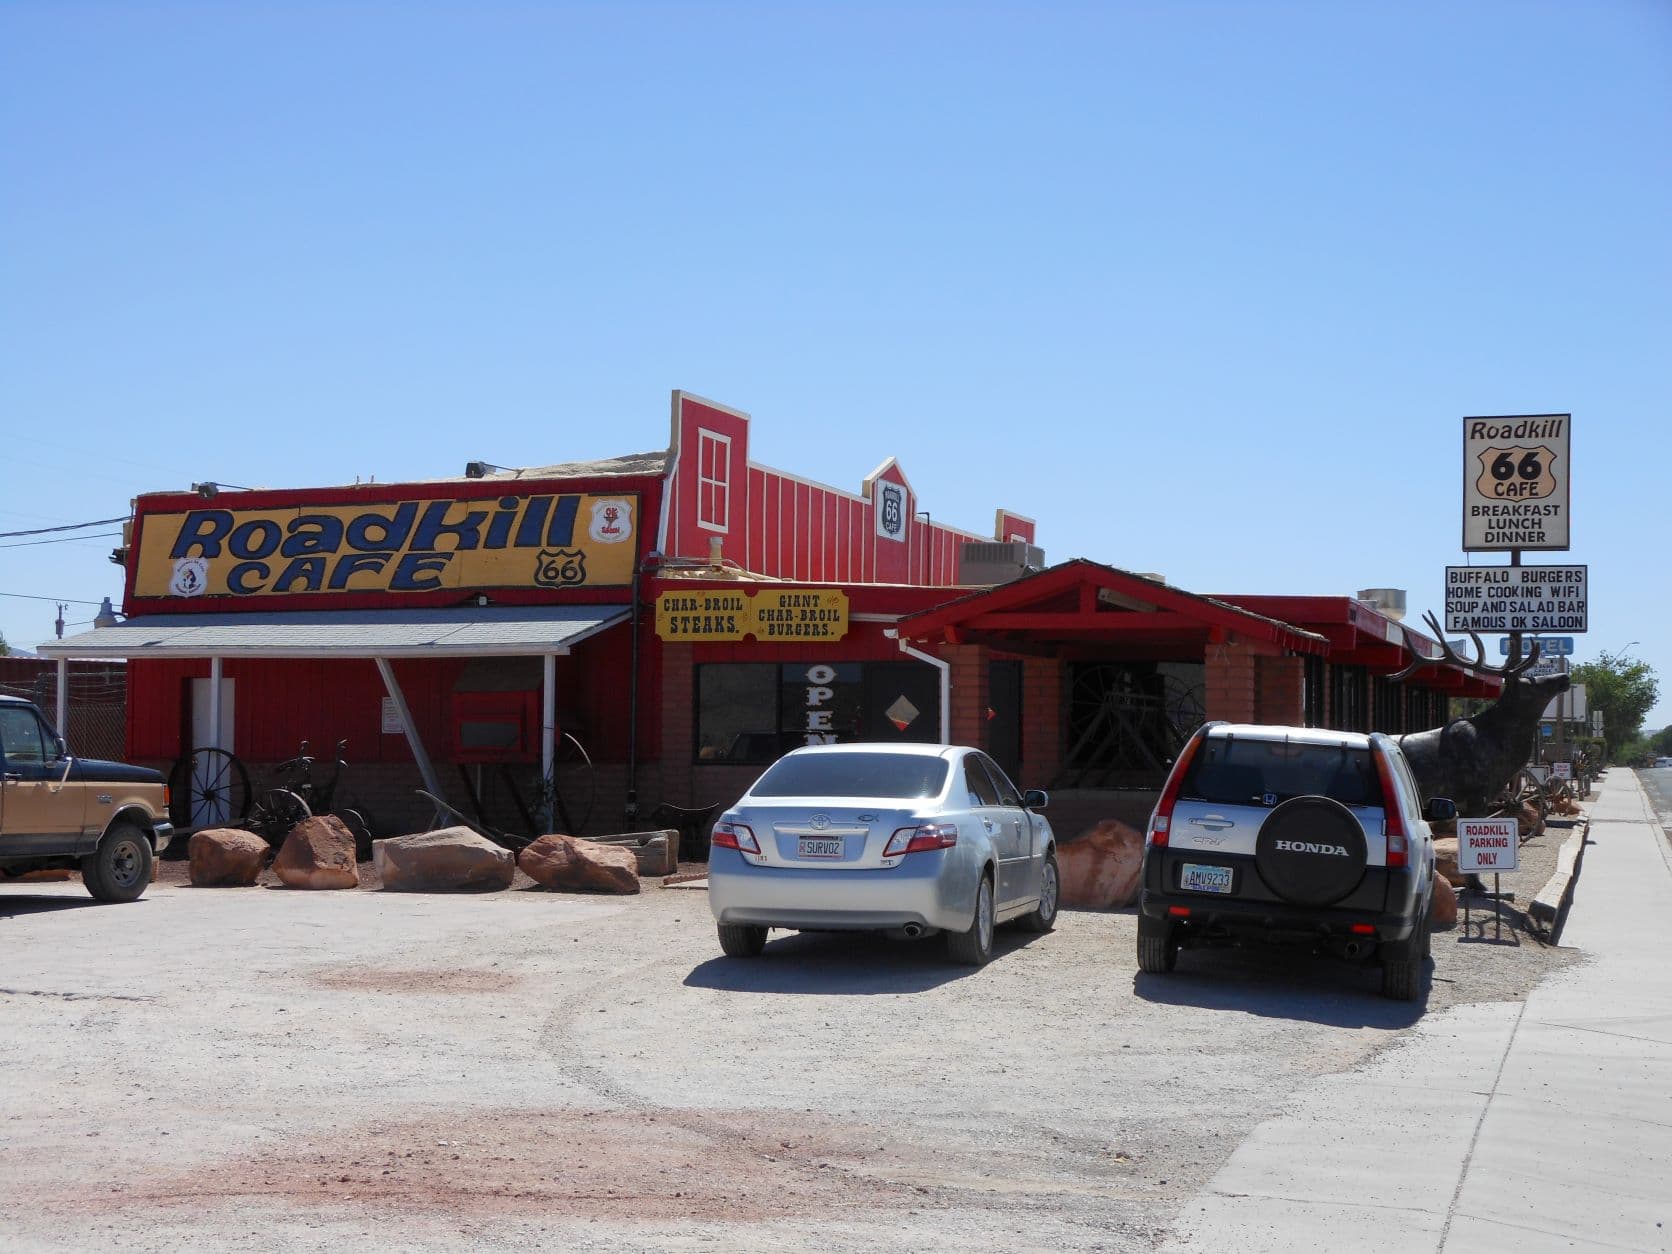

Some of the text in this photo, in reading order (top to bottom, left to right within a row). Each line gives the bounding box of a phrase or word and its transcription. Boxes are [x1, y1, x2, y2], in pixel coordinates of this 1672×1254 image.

[1470, 419, 1564, 439] Roadkill
[1491, 452, 1542, 481] 66
[1494, 482, 1539, 496] CAFE
[886, 500, 898, 521] 66
[1471, 505, 1561, 517] BREAKFAST
[170, 495, 582, 559] Roadkill
[1488, 518, 1542, 529] LUNCH
[1484, 532, 1546, 543] DINNER
[226, 551, 455, 594] CAFE
[541, 558, 579, 579] 66
[1450, 570, 1582, 583] BUFFALO BURGERS
[1448, 586, 1580, 598] HOME COOKING WIFI
[663, 598, 743, 611] CHAR-BROIL
[779, 595, 820, 607] GIANT
[1447, 600, 1585, 613] SOUP AND SALAD BAR
[758, 609, 840, 622] CHAR-BROIL
[1453, 616, 1583, 628] FAMOUS OK SALOON
[670, 616, 740, 634] STEAKS.
[768, 623, 835, 636] BURGERS.
[1466, 825, 1509, 835] ROADKILL
[1275, 840, 1350, 857] HONDA
[1469, 838, 1508, 848] PARKING
[1477, 853, 1497, 865] ONLY
